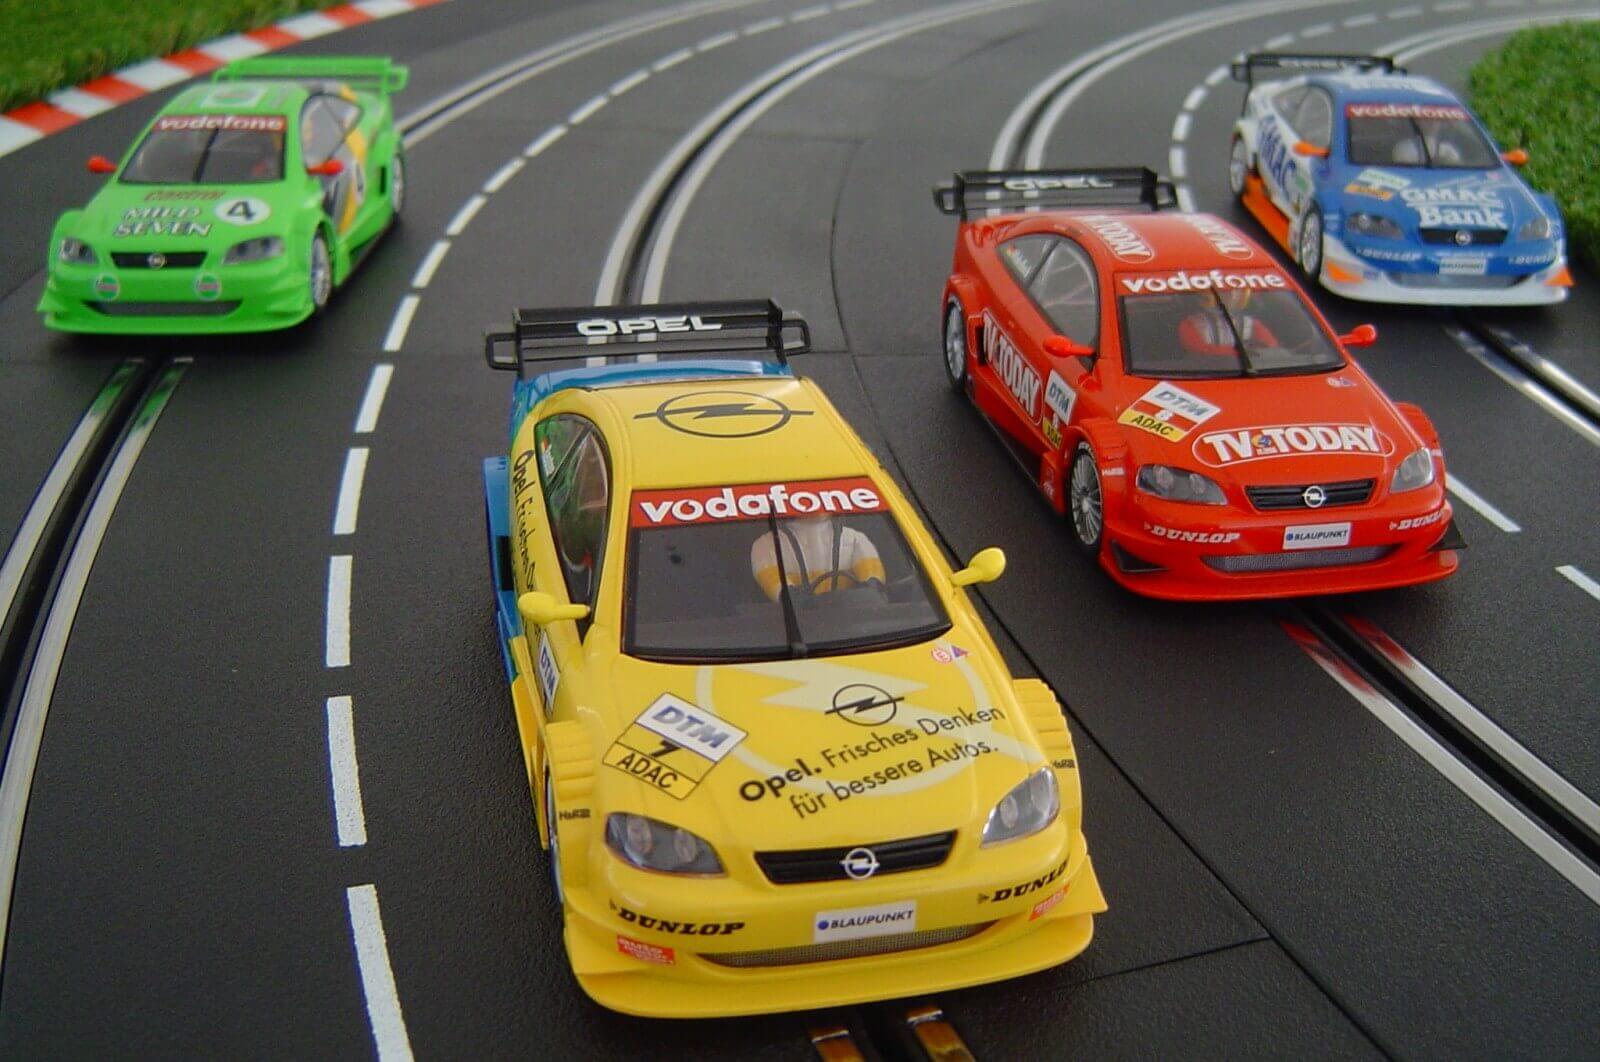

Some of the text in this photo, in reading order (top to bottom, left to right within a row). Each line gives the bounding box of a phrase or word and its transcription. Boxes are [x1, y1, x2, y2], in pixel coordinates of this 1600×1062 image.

[160, 116, 283, 131] vodafone
[1351, 105, 1466, 120] vodafone
[1004, 176, 1114, 190] OPEL
[1400, 187, 1497, 201] GMAC
[226, 200, 257, 221] 4
[1418, 207, 1509, 230] Bank
[112, 221, 213, 238] SEVEN
[1121, 270, 1286, 294] vodafone
[575, 315, 723, 336] OPEL
[998, 334, 1040, 418] TODAY
[1131, 413, 1175, 437] ADAC
[1203, 425, 1380, 462] TV TODAY
[640, 484, 881, 523] vodafone
[1150, 526, 1241, 544] DUNLOP
[1293, 528, 1350, 542] BLAUPUNKT
[651, 704, 731, 749] DTM
[739, 705, 1005, 801] Opel. Frisches Denken
[615, 753, 678, 789] ADAC
[789, 738, 999, 820] für bessere Autos.
[618, 903, 744, 935] DUNLOP
[830, 909, 914, 929] BLAUPUNKT
